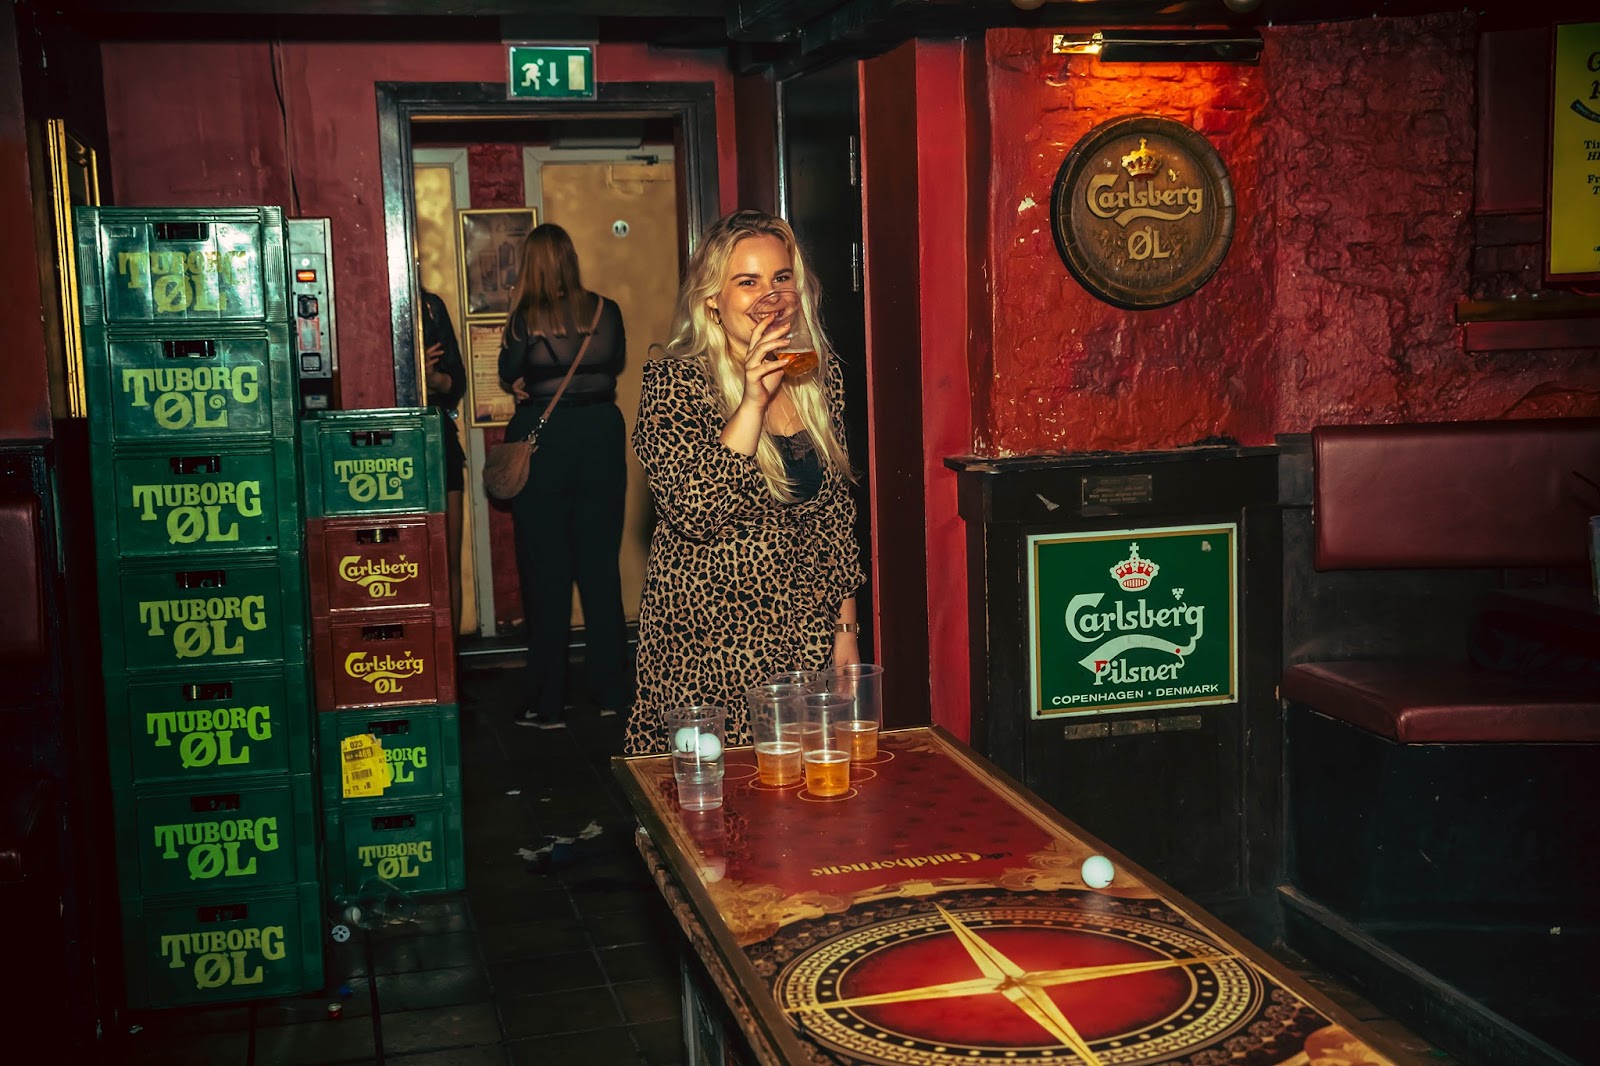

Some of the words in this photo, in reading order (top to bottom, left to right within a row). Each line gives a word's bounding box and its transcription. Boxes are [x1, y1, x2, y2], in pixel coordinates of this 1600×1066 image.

[1086, 174, 1203, 218] Carlsberg
[1127, 225, 1171, 261] ØL
[153, 274, 227, 314] ØL
[122, 366, 259, 407] TUBORG
[153, 391, 228, 430] ØL
[334, 457, 414, 483] TUBORG
[348, 473, 404, 503] ØL
[132, 480, 262, 521] TUBORG
[166, 505, 239, 545] ØL
[339, 555, 419, 583] Carlsberg
[368, 582, 398, 598] ØL
[139, 595, 267, 636] TUBORG
[1065, 592, 1205, 643] Carlsberg
[173, 620, 244, 659] ØL
[345, 651, 424, 678] Carlsberg
[1093, 657, 1185, 686] Pilsner
[374, 678, 403, 694] ØL
[1051, 689, 1144, 706] COPENHAGEN
[1155, 683, 1219, 698] DENMARK
[146, 705, 272, 747] TUBORG
[179, 730, 250, 769] ØL
[384, 746, 428, 769] BORG
[154, 816, 279, 859] TUBORG
[358, 840, 433, 867] TUBORG
[187, 841, 257, 881] ØL
[377, 855, 419, 880] ØL
[810, 851, 982, 877] Guldhornene
[160, 925, 286, 969] TUBORG
[194, 950, 263, 990] ØL
